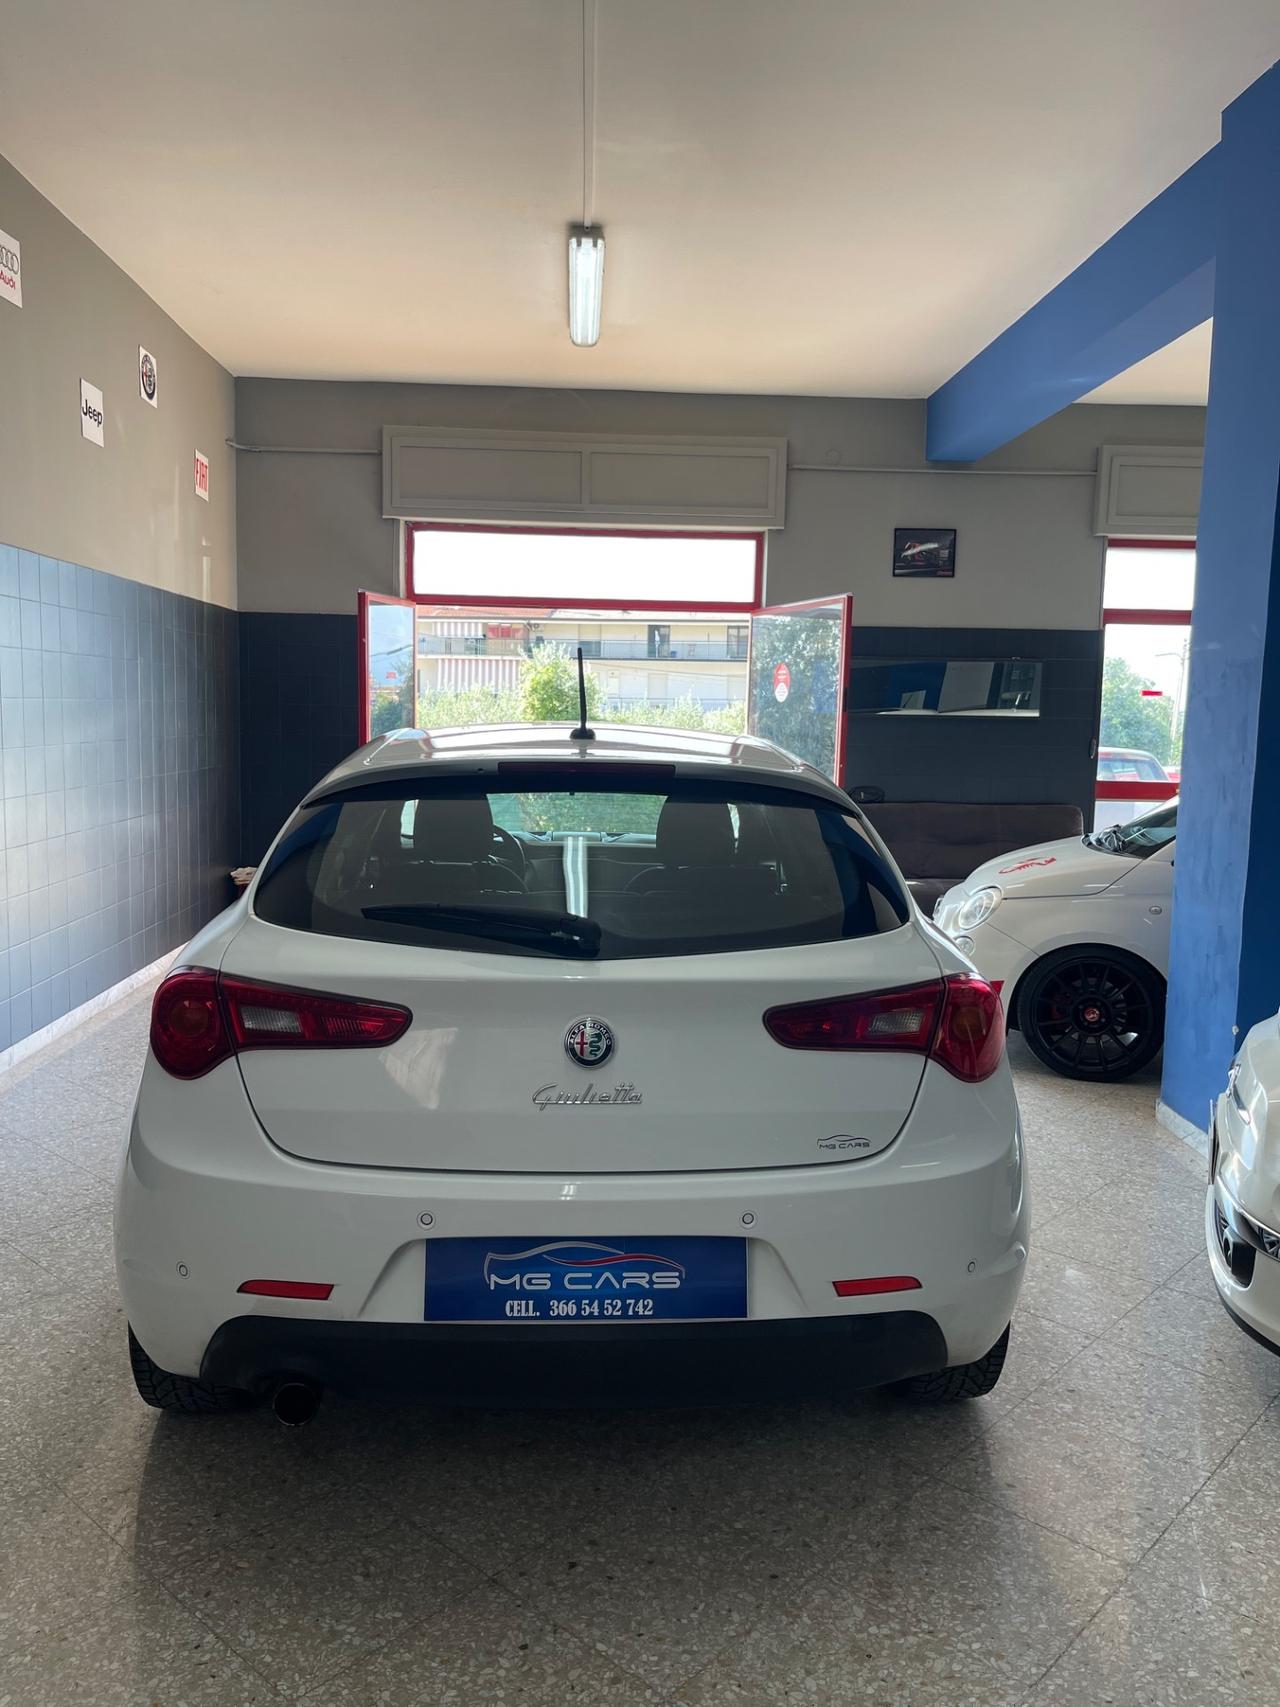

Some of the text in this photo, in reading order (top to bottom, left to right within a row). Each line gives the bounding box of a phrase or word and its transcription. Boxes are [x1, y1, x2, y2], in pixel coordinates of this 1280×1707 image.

[81, 399, 103, 427] Jeep
[569, 1022, 612, 1046] ALFA ROMEO
[532, 1083, 642, 1111] Giulietta
[490, 1271, 681, 1290] MG CARS
[505, 1299, 654, 1317] CELL. 366 54 52 742
